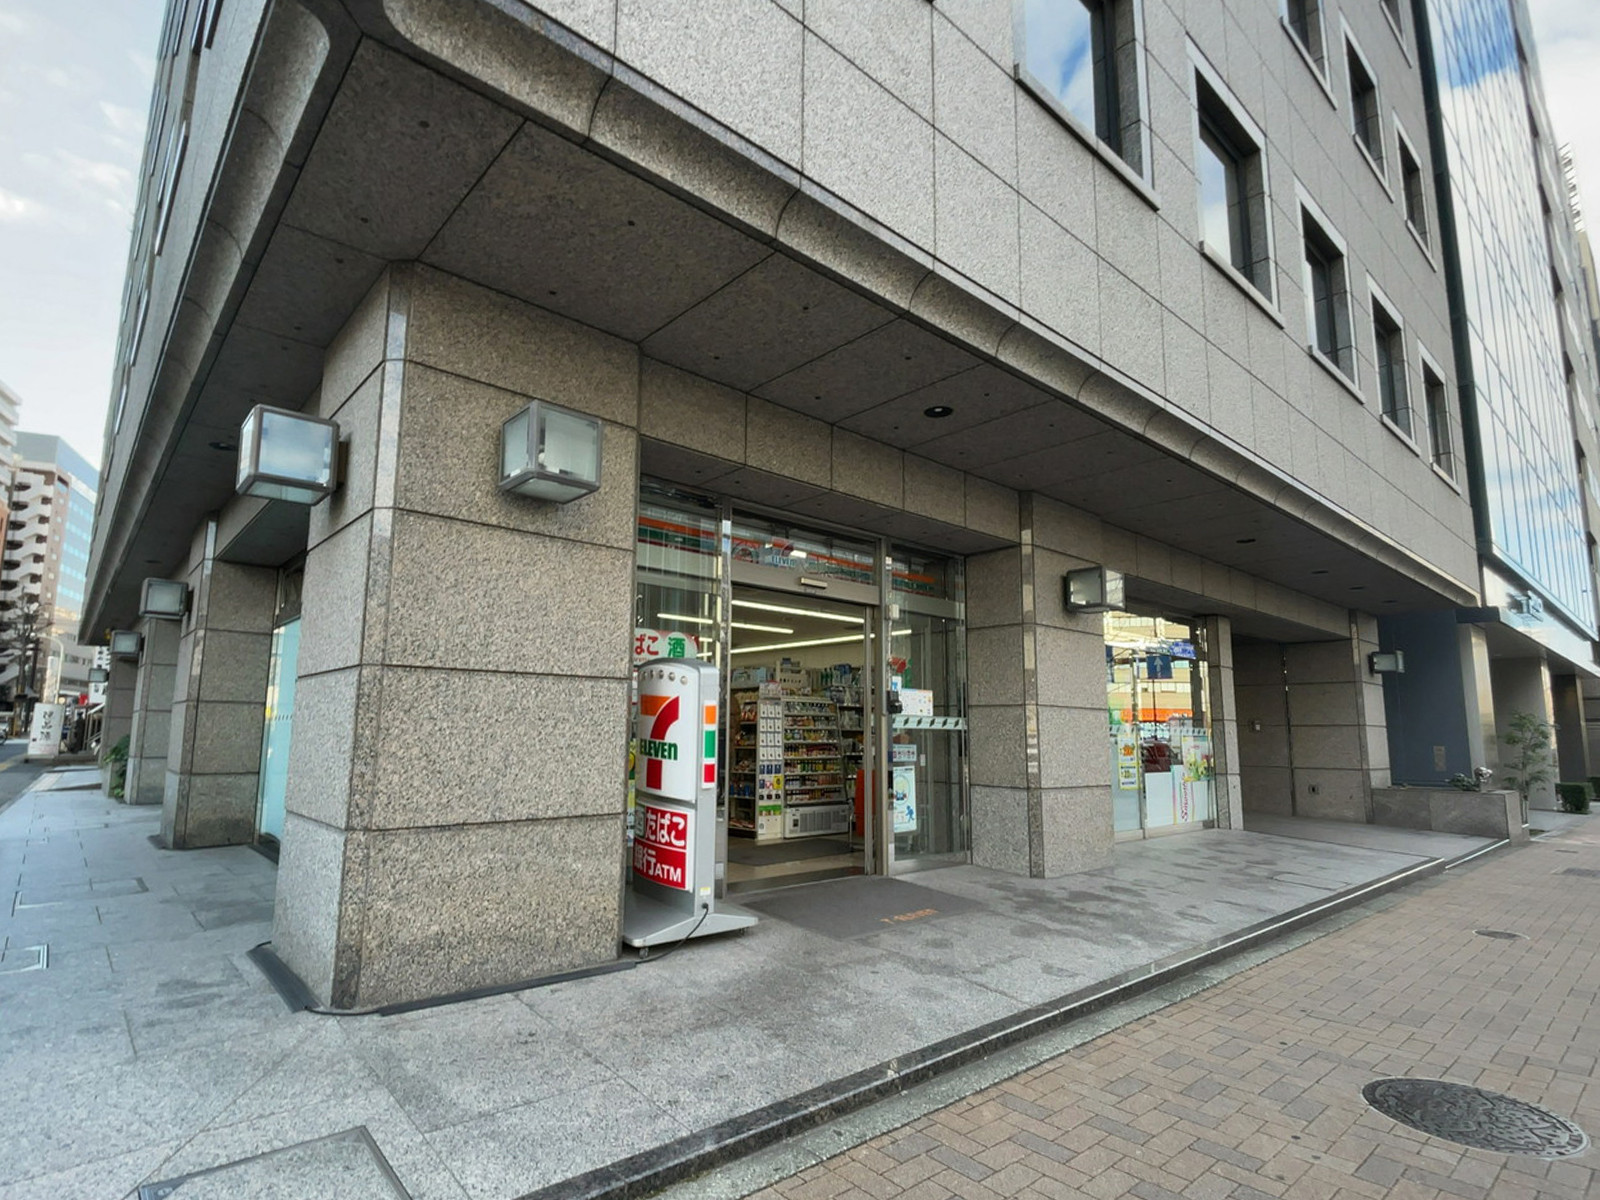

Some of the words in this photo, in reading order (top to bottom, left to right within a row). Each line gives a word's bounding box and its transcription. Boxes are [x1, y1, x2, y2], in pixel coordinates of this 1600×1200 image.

[667, 636, 686, 659] 酒
[645, 809, 686, 847] たばこ
